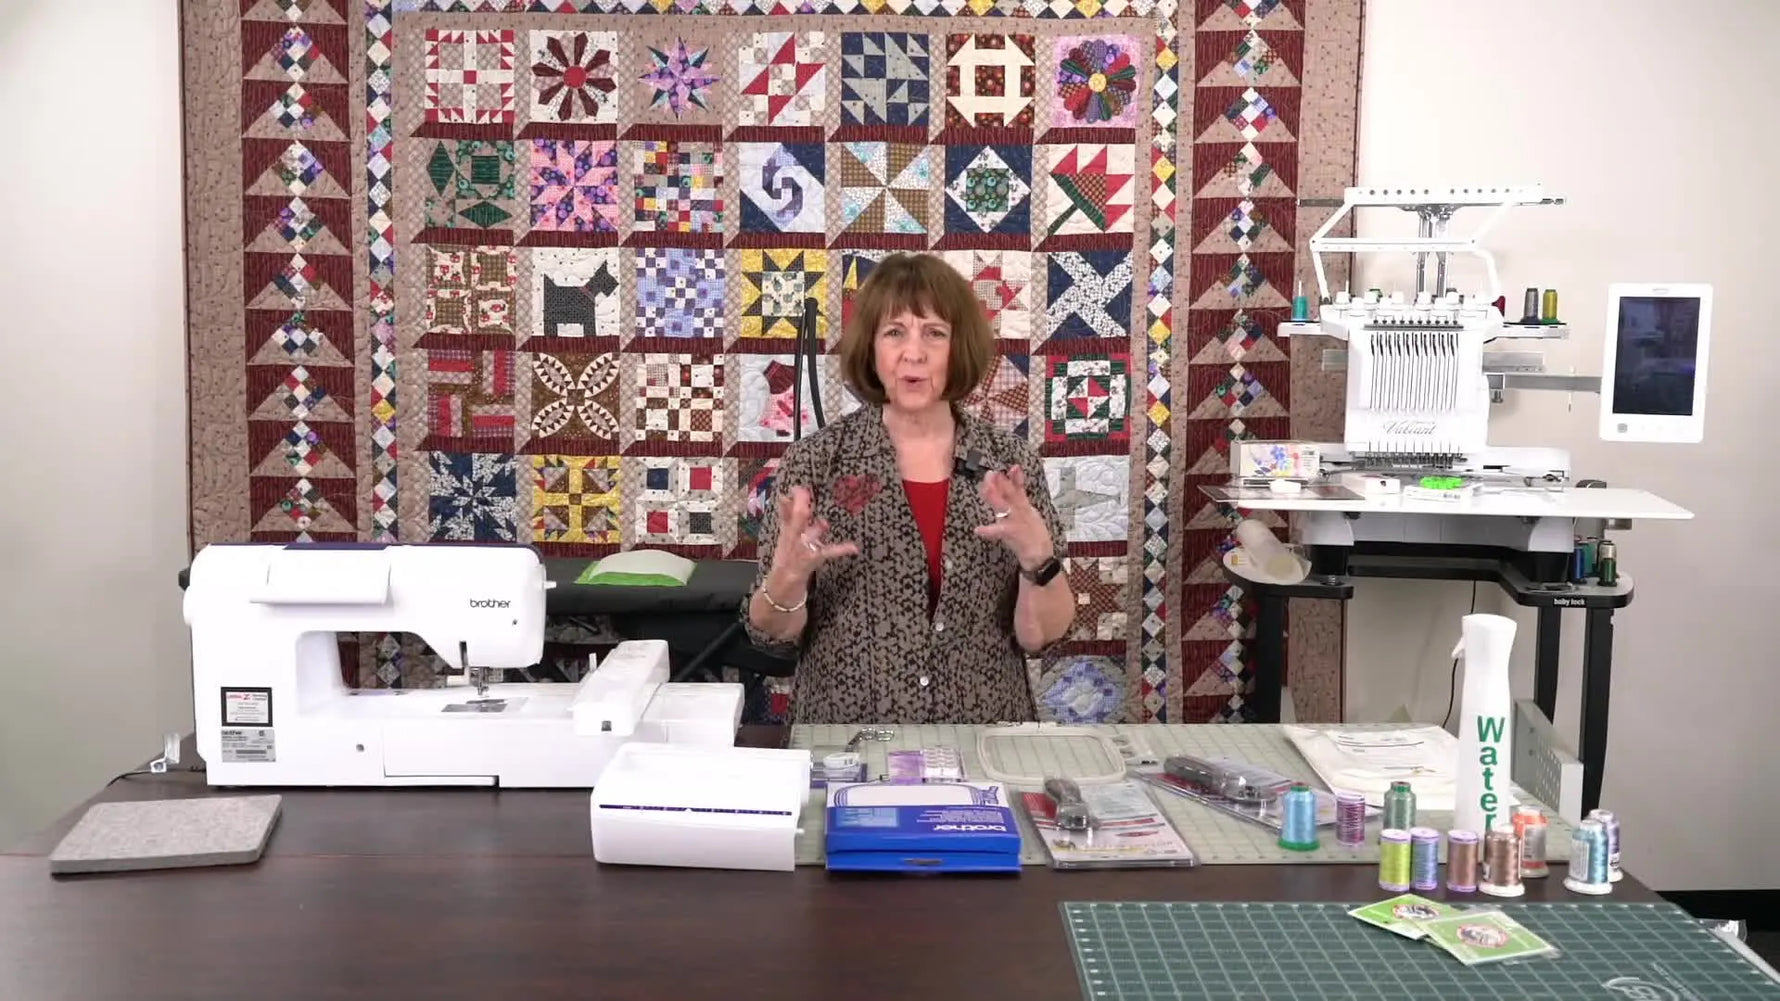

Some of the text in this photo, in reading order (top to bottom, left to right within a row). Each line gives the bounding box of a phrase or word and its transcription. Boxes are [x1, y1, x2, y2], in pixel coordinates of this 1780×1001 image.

[470, 598, 511, 608] brother
[1553, 598, 1585, 607] baby lock
[1477, 715, 1505, 832] Water
[933, 824, 1007, 832] brother
